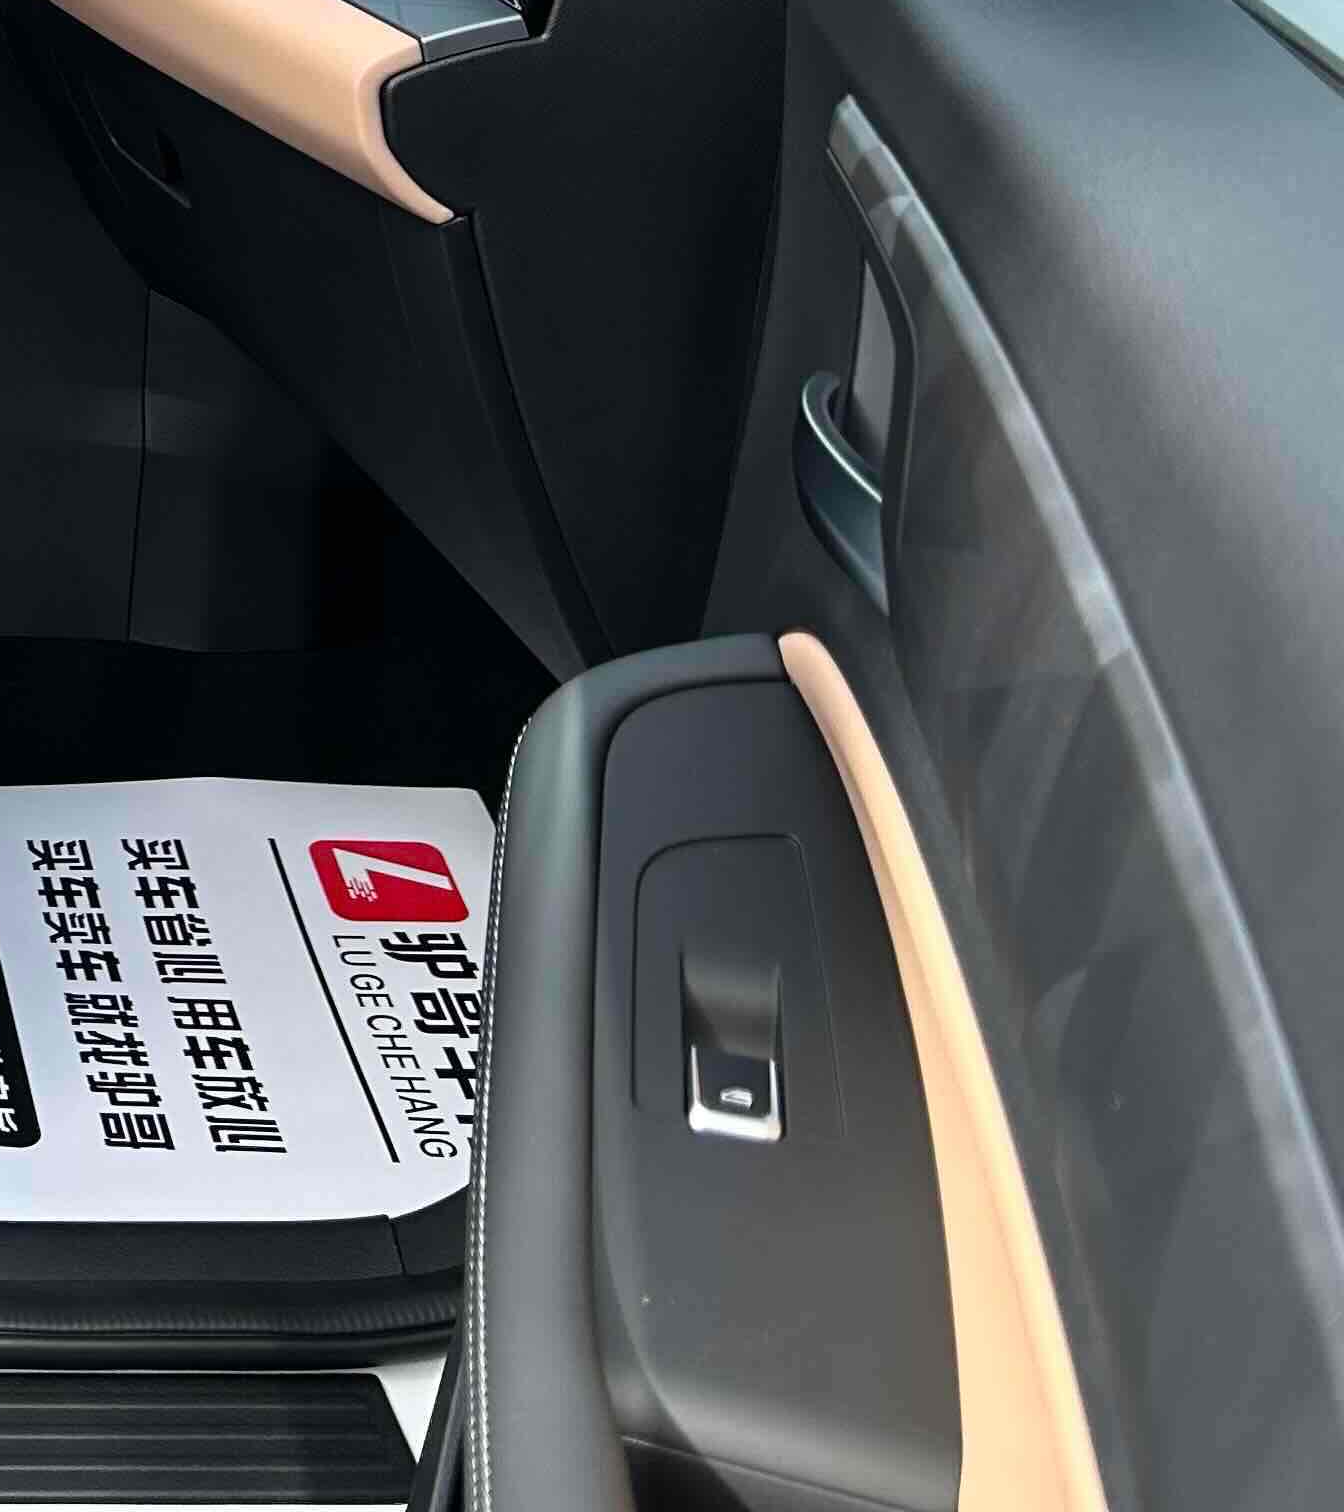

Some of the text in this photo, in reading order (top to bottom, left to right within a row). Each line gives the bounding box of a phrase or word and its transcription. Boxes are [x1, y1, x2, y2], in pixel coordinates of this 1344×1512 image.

[26, 839, 176, 1151] 买车卖车 就找驴哥
[120, 839, 287, 1154] 买车省心 用车放心
[378, 931, 484, 1144] 驴哥
